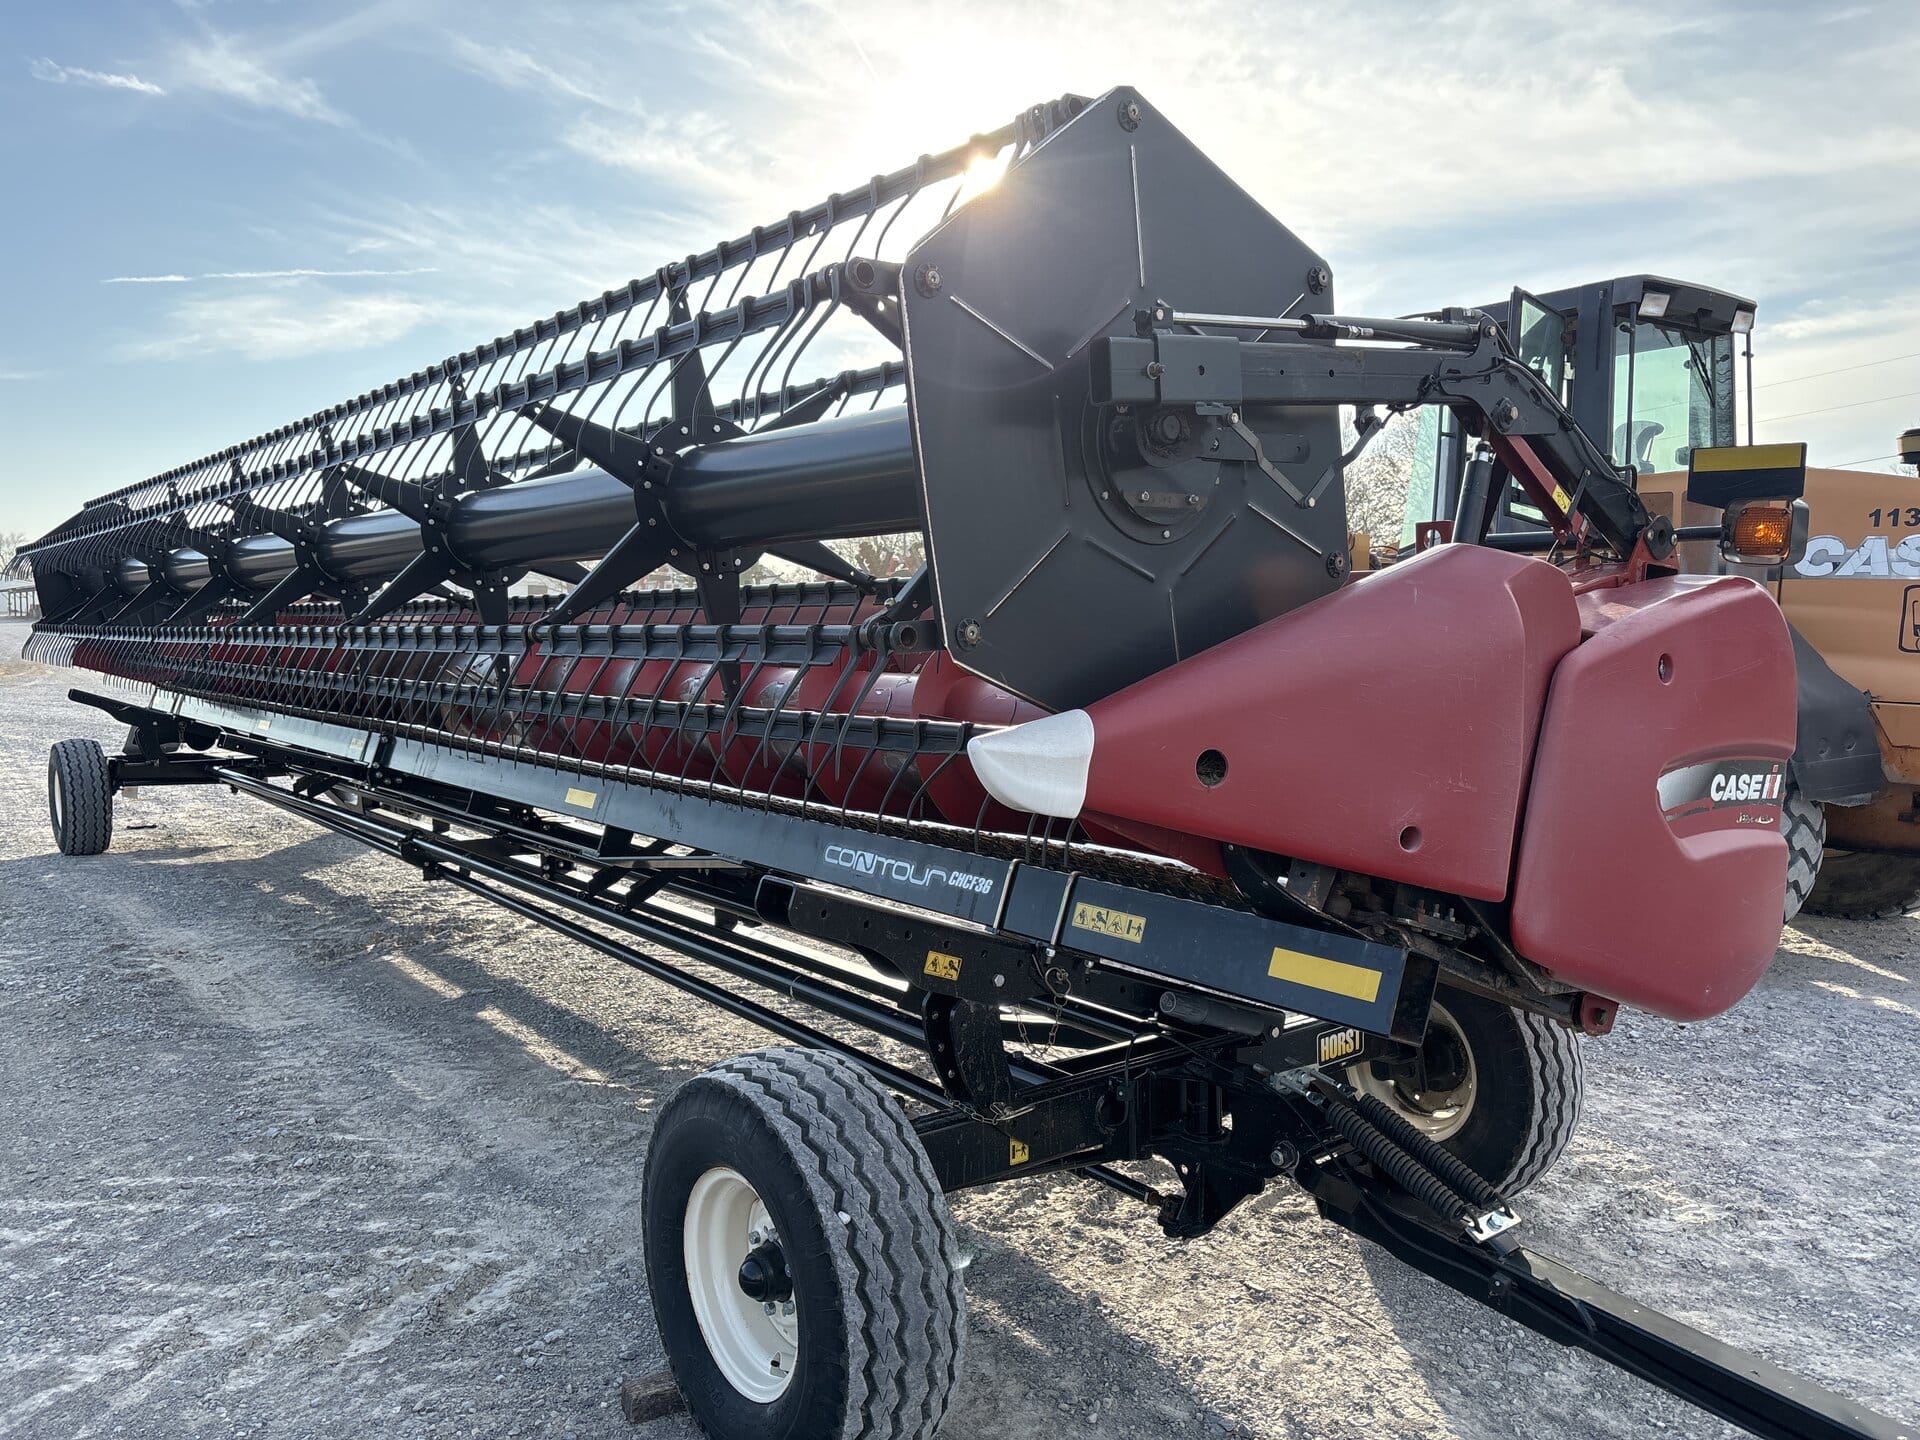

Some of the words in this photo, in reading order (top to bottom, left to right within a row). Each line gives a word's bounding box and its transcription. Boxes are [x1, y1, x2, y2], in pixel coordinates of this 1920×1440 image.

[824, 844, 947, 887] CONTOUR
[948, 870, 994, 895] CHCF36
[1320, 1028, 1360, 1062] HORST
